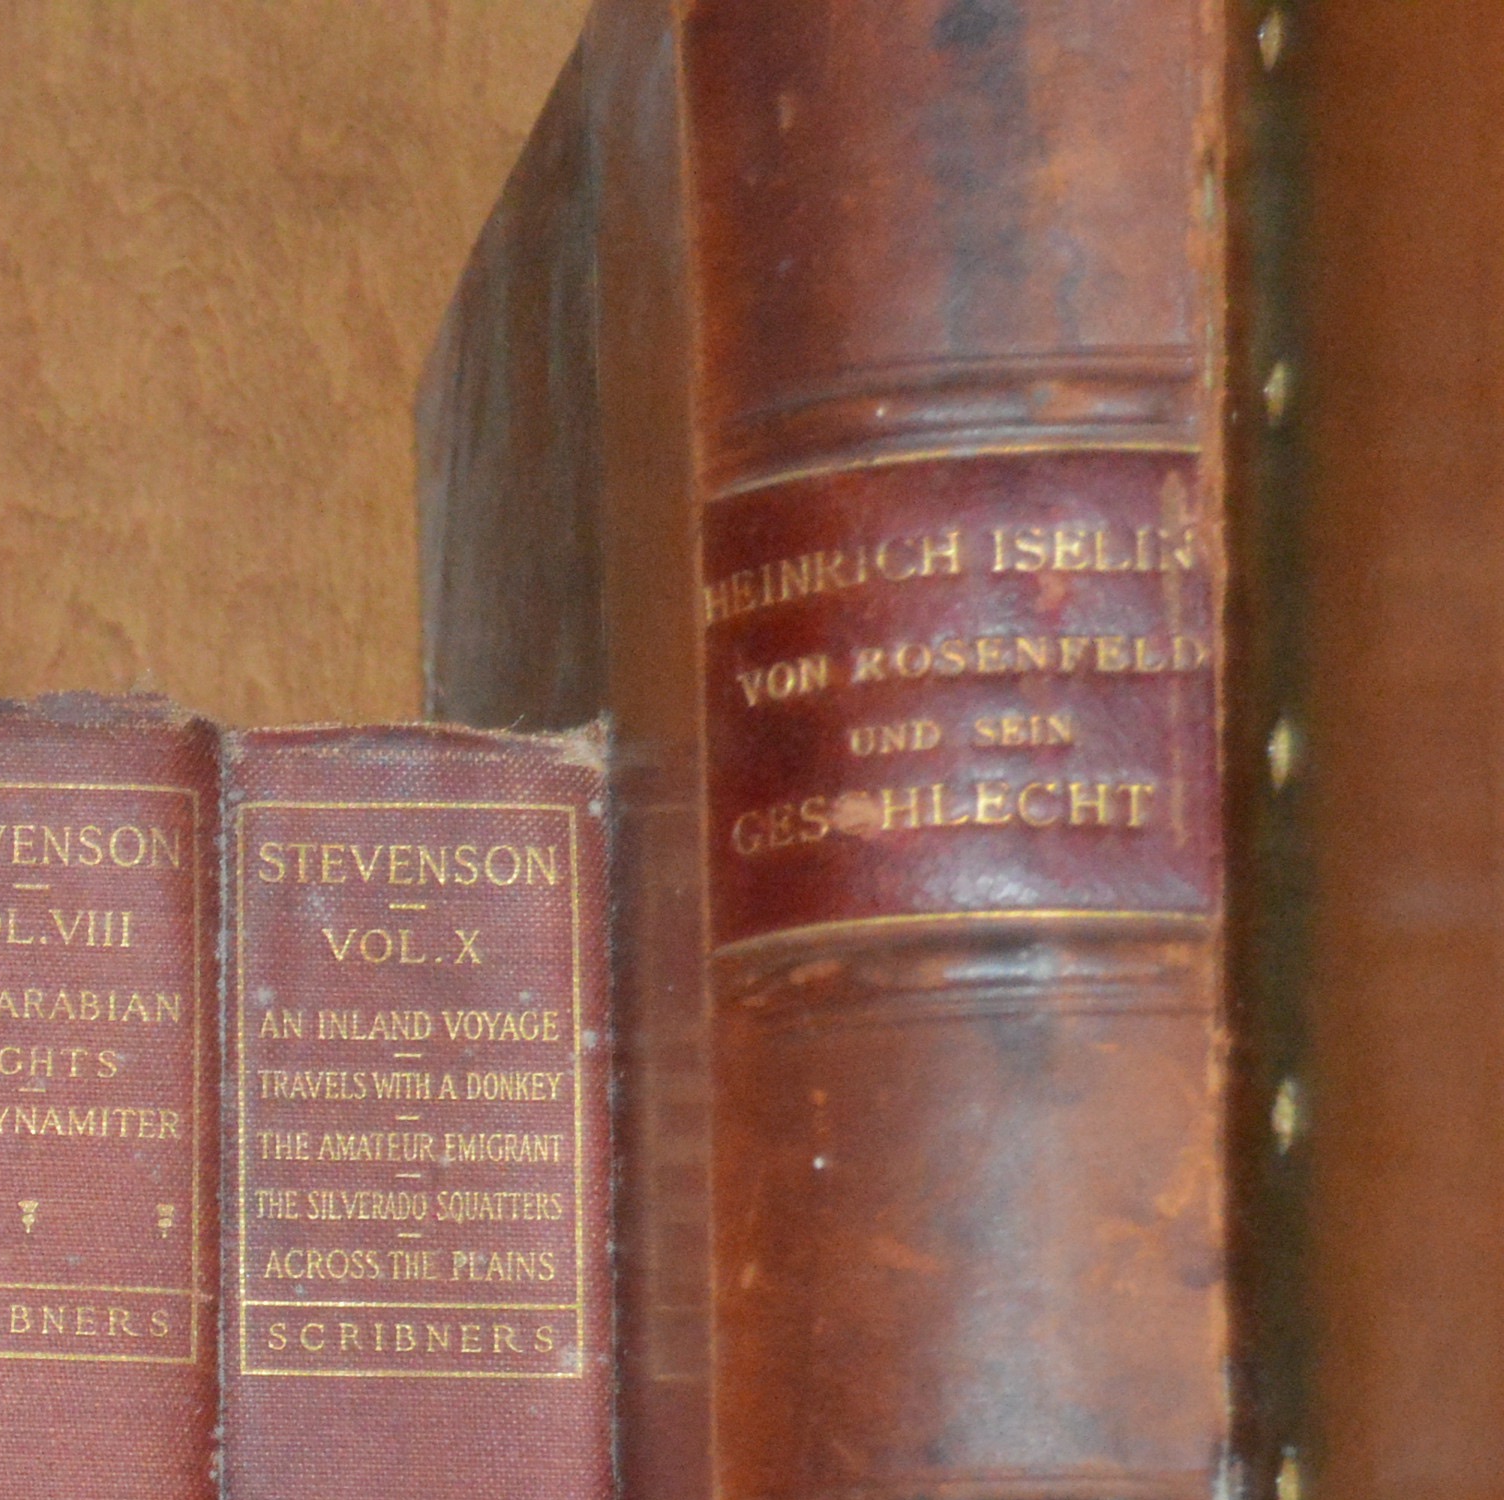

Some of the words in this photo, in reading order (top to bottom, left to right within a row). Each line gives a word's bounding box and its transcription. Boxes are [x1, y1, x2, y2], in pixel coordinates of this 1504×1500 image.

[704, 530, 962, 624] HEINRICH
[992, 526, 1195, 574] ISELIN
[736, 652, 829, 708] VON
[852, 634, 1212, 684] ROSENFELD
[849, 718, 942, 757] UND
[974, 713, 1075, 747] SEIN
[258, 842, 560, 886] STEVENSON
[322, 928, 441, 963] VOL.
[455, 930, 483, 964] X
[260, 1011, 303, 1039] AN
[318, 1011, 431, 1041] INLAND
[444, 1011, 560, 1043] VOYAGE
[258, 1071, 367, 1098] TRAVELS
[372, 1072, 431, 1100] WITH
[439, 1072, 457, 1100] A
[467, 1072, 562, 1101] DONKEY
[260, 1132, 310, 1160] THE
[319, 1133, 435, 1161] AMATEUR
[444, 1134, 562, 1162] EMIGRANT
[256, 1191, 301, 1219] THE
[307, 1191, 428, 1221] SILVERADO
[437, 1191, 562, 1221] SQUATTERS
[264, 1250, 380, 1280] ACROSS
[390, 1251, 437, 1279] THE
[453, 1251, 554, 1282] PLAINS
[268, 1322, 554, 1351] SCRIBNERS
